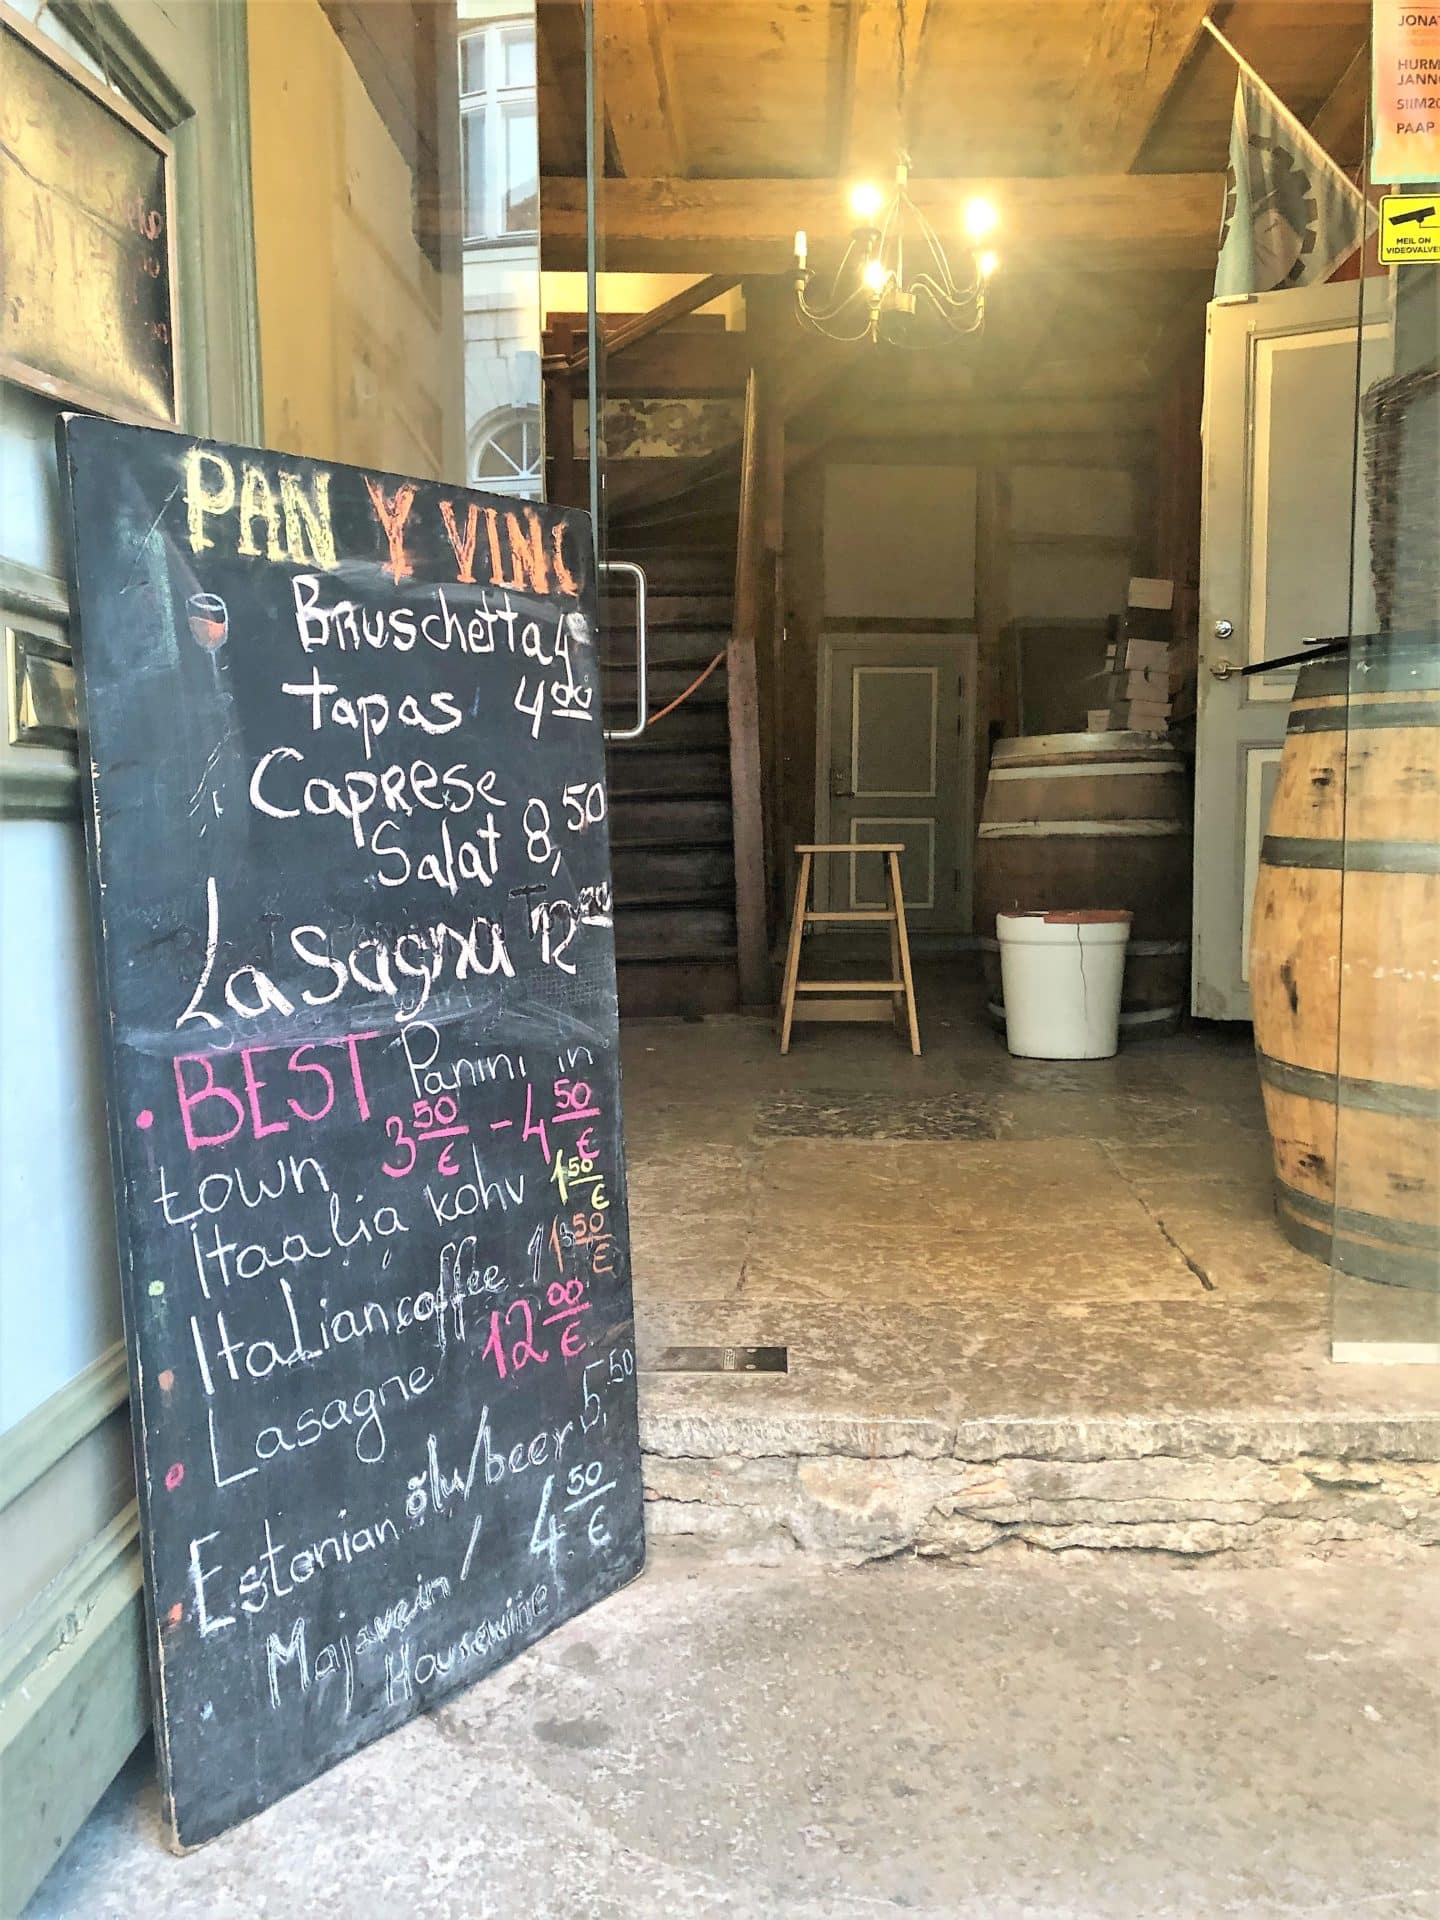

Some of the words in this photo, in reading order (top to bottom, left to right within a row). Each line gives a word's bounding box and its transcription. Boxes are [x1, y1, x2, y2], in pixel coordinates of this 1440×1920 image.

[1398, 14, 1440, 26] JONA
[1397, 73, 1440, 86] JANN
[1396, 121, 1435, 134] PAAP
[1386, 246, 1440, 254] VIDEOVALVE
[1396, 237, 1416, 245] MEIL
[1418, 236, 1431, 244] ON
[184, 448, 341, 572] PAN
[364, 474, 418, 585] Y
[282, 665, 463, 760] tapas
[371, 812, 501, 897] Salat
[172, 1031, 387, 1151] BEST
[558, 1046, 594, 1073] in
[154, 1156, 332, 1226] town
[422, 1143, 526, 1228] kohv
[208, 1364, 435, 1488] Lasagne
[190, 1511, 400, 1639] Estonian
